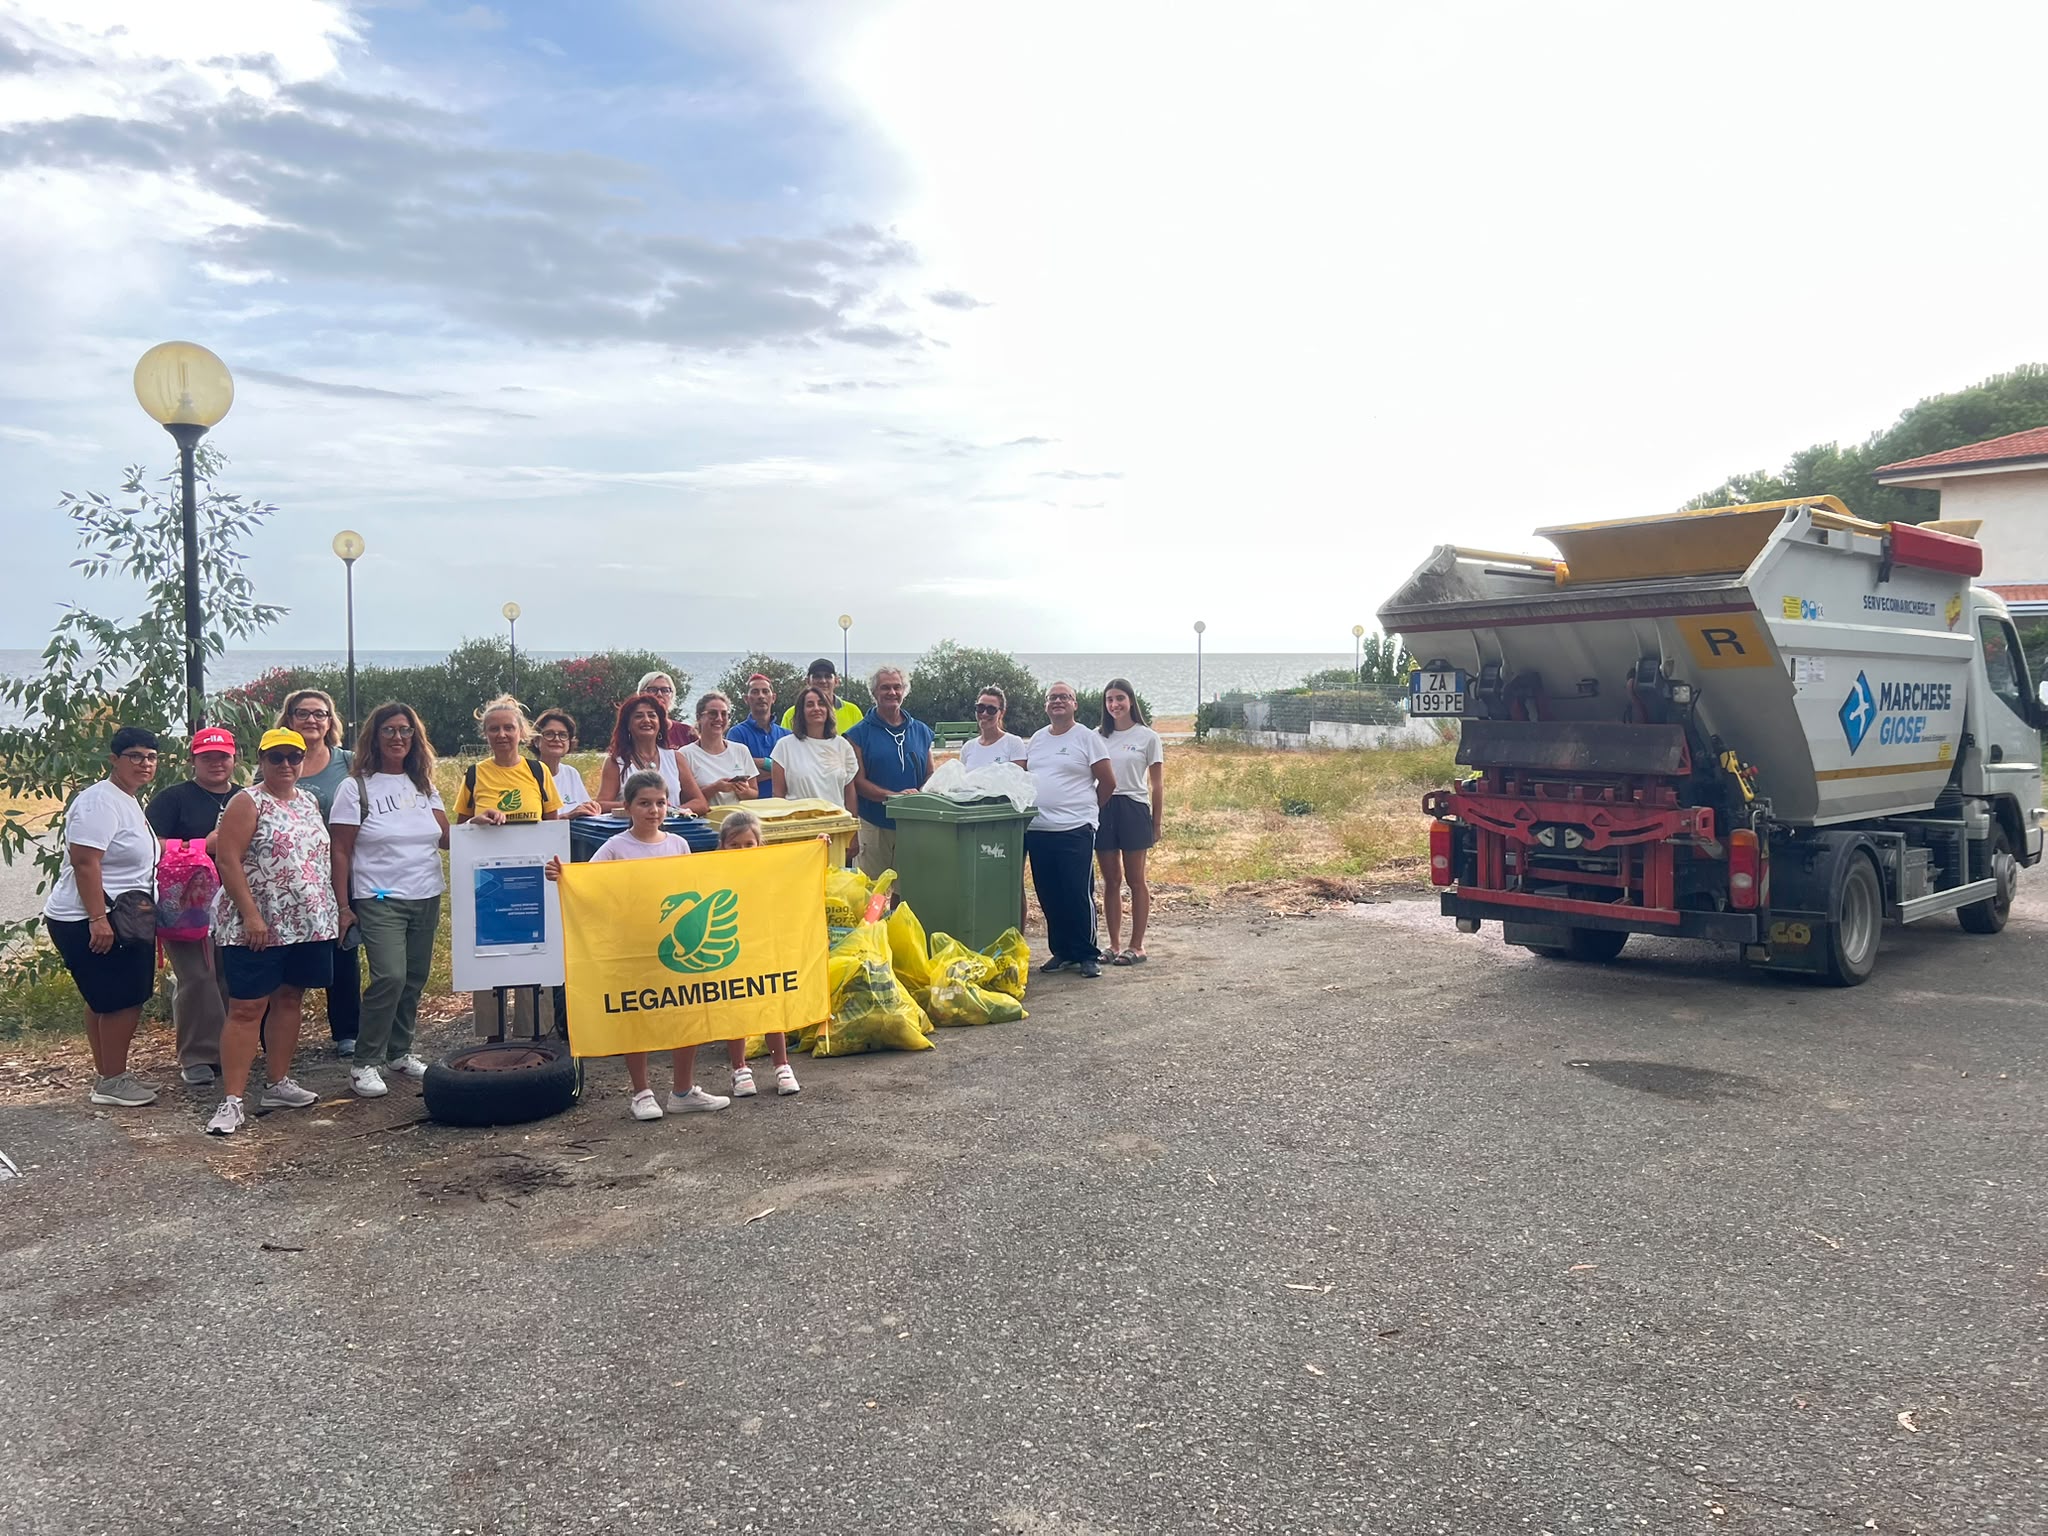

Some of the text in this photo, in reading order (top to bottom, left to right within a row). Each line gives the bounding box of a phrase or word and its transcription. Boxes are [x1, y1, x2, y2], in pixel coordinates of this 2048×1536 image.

[1701, 628, 1746, 656] R
[1429, 674, 1447, 691] ZA
[1415, 694, 1463, 711] 199 PE
[1879, 682, 1952, 712] MARCHESE
[603, 970, 798, 1014] LEGAMBIENTE
